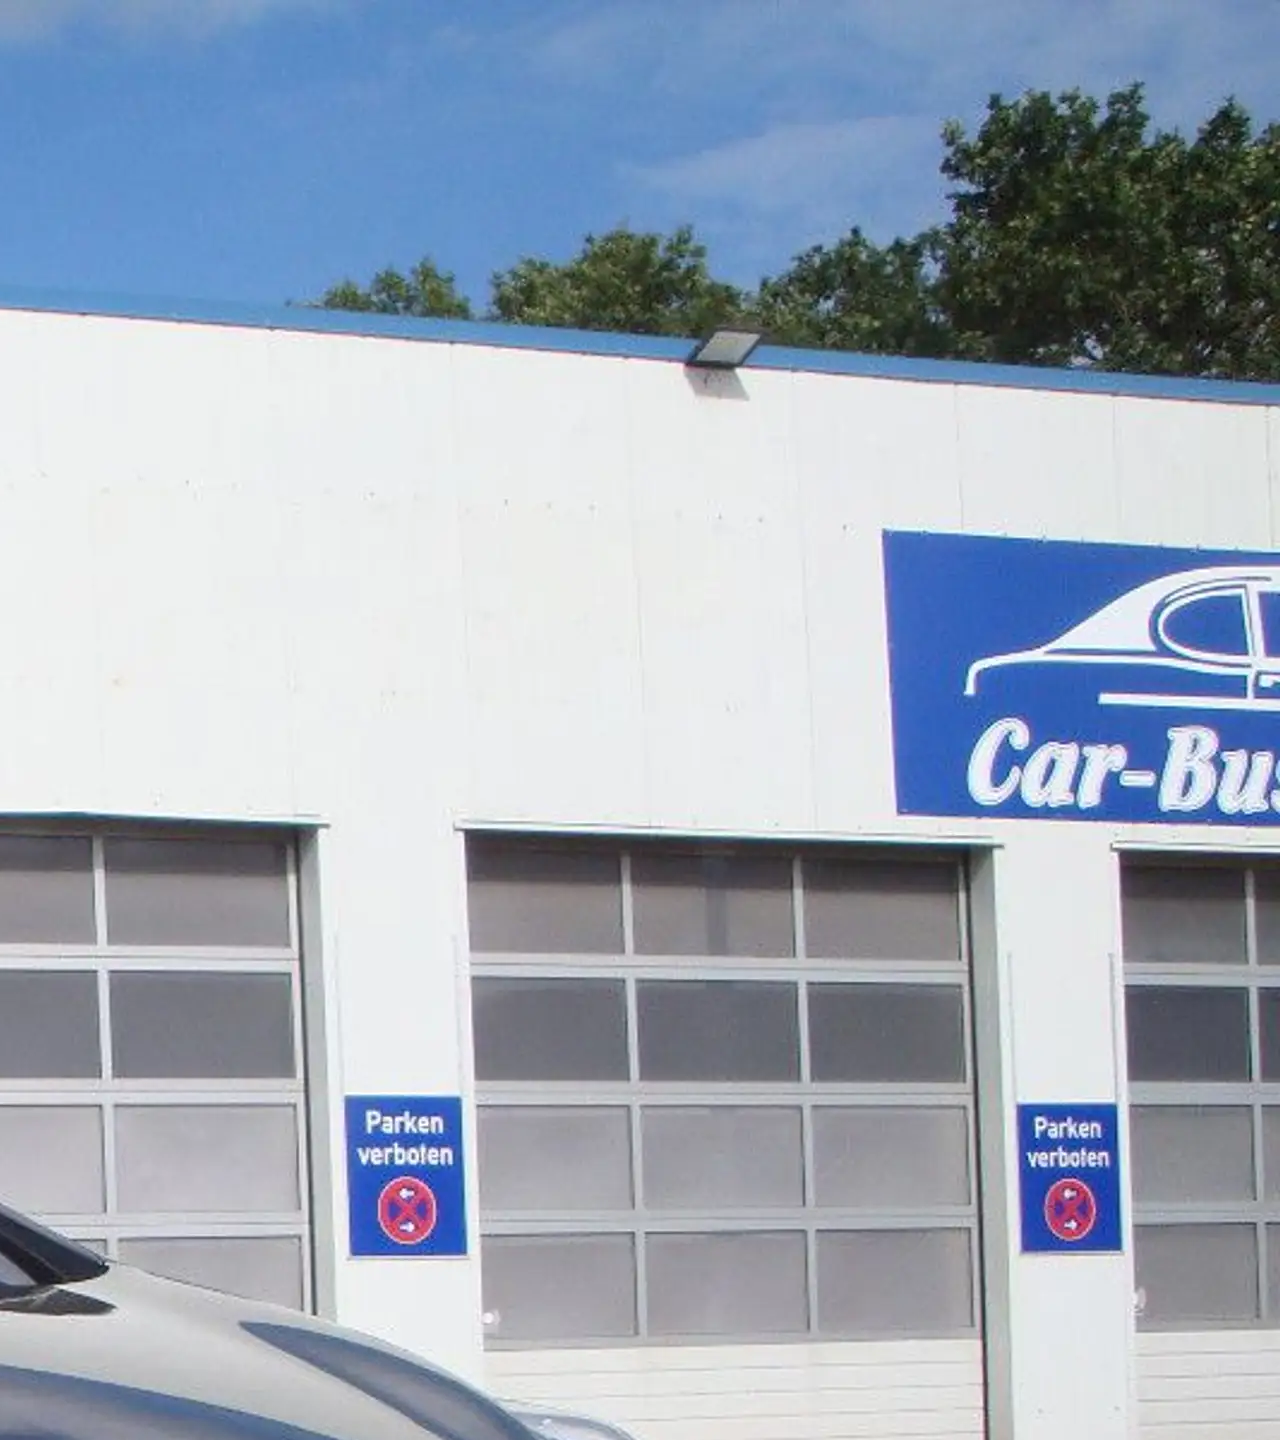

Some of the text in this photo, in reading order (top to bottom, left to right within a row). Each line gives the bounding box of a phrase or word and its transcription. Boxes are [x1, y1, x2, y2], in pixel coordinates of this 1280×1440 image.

[967, 717, 1280, 815] Car-Bu
[365, 1109, 444, 1134] Parken
[1033, 1115, 1102, 1139] Parken
[356, 1142, 454, 1166] verboten
[1026, 1145, 1110, 1168] verboten
